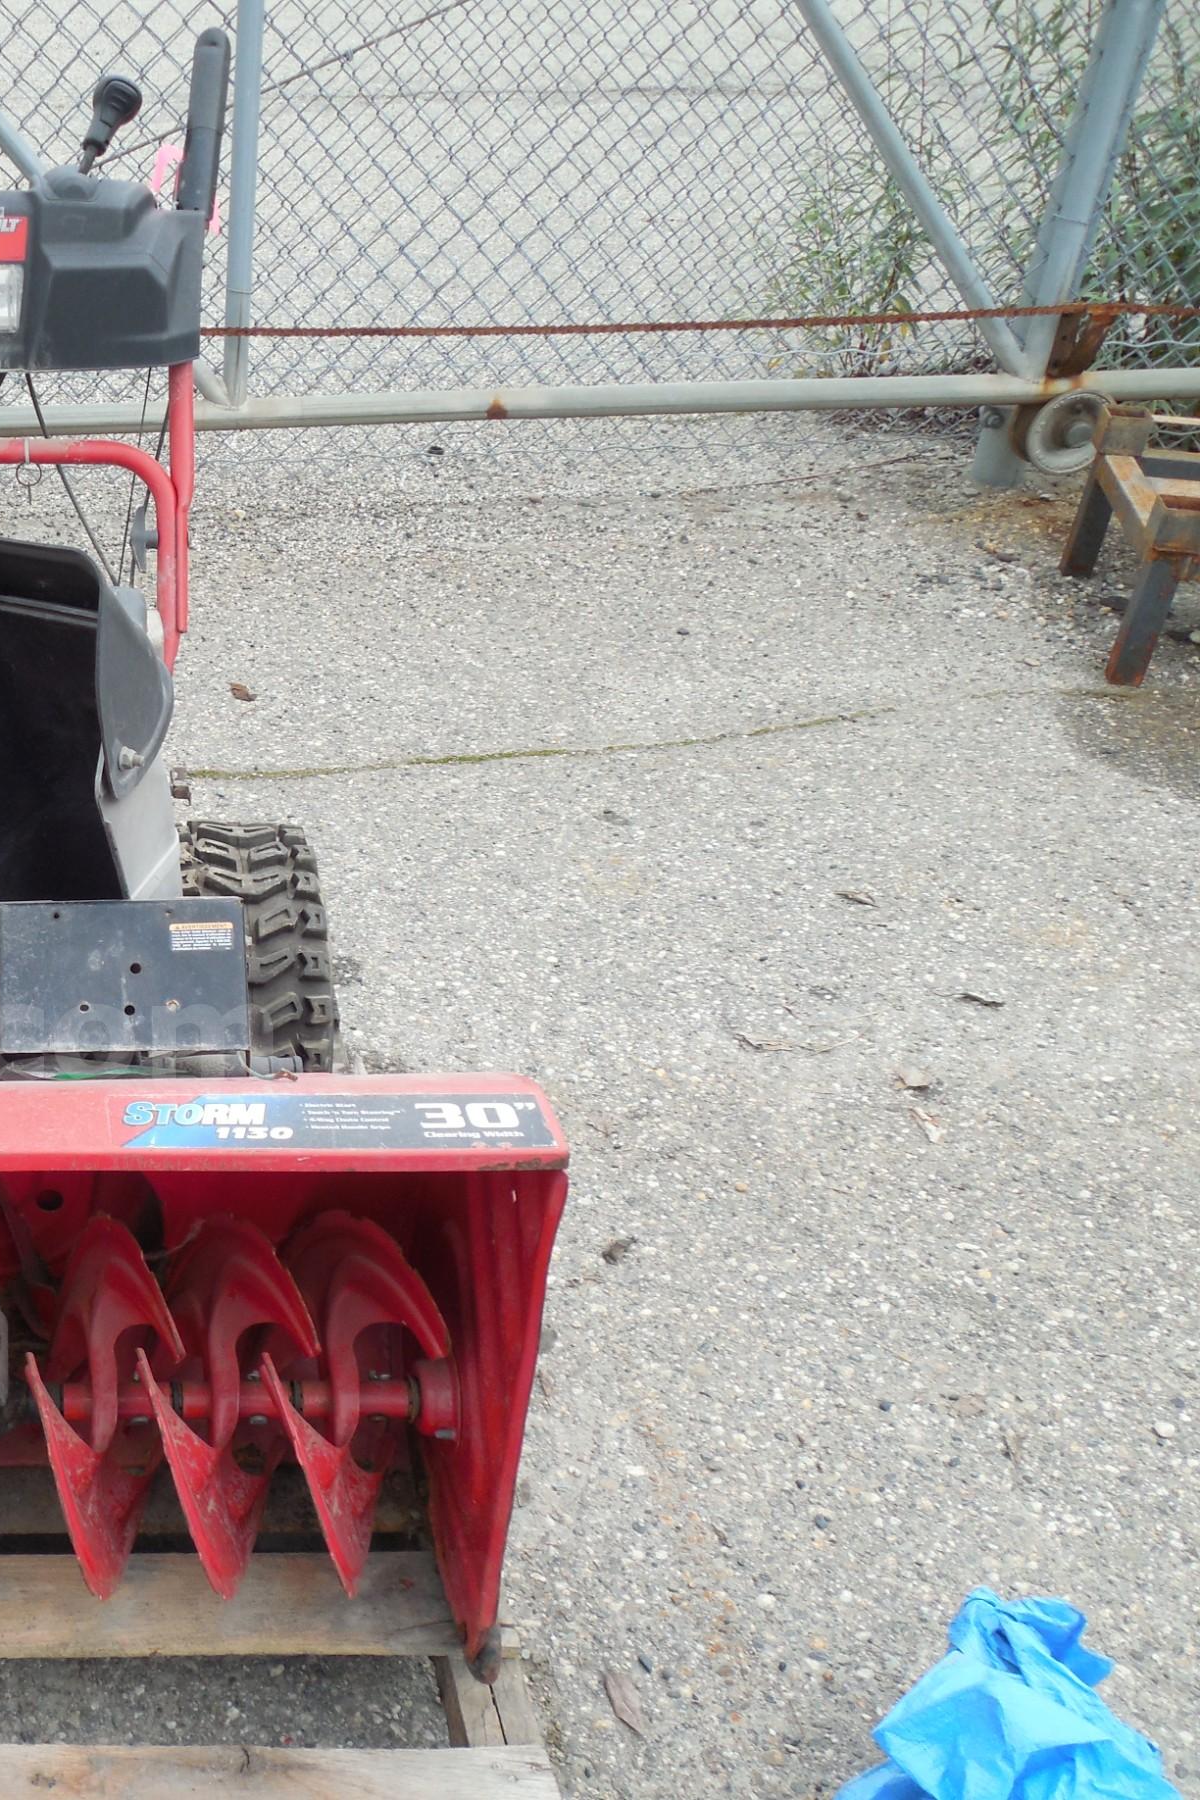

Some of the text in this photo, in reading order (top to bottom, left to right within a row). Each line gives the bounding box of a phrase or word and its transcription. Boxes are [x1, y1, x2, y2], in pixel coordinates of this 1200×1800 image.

[123, 1101, 266, 1126] STORM
[423, 1130, 525, 1139] Clearing Width
